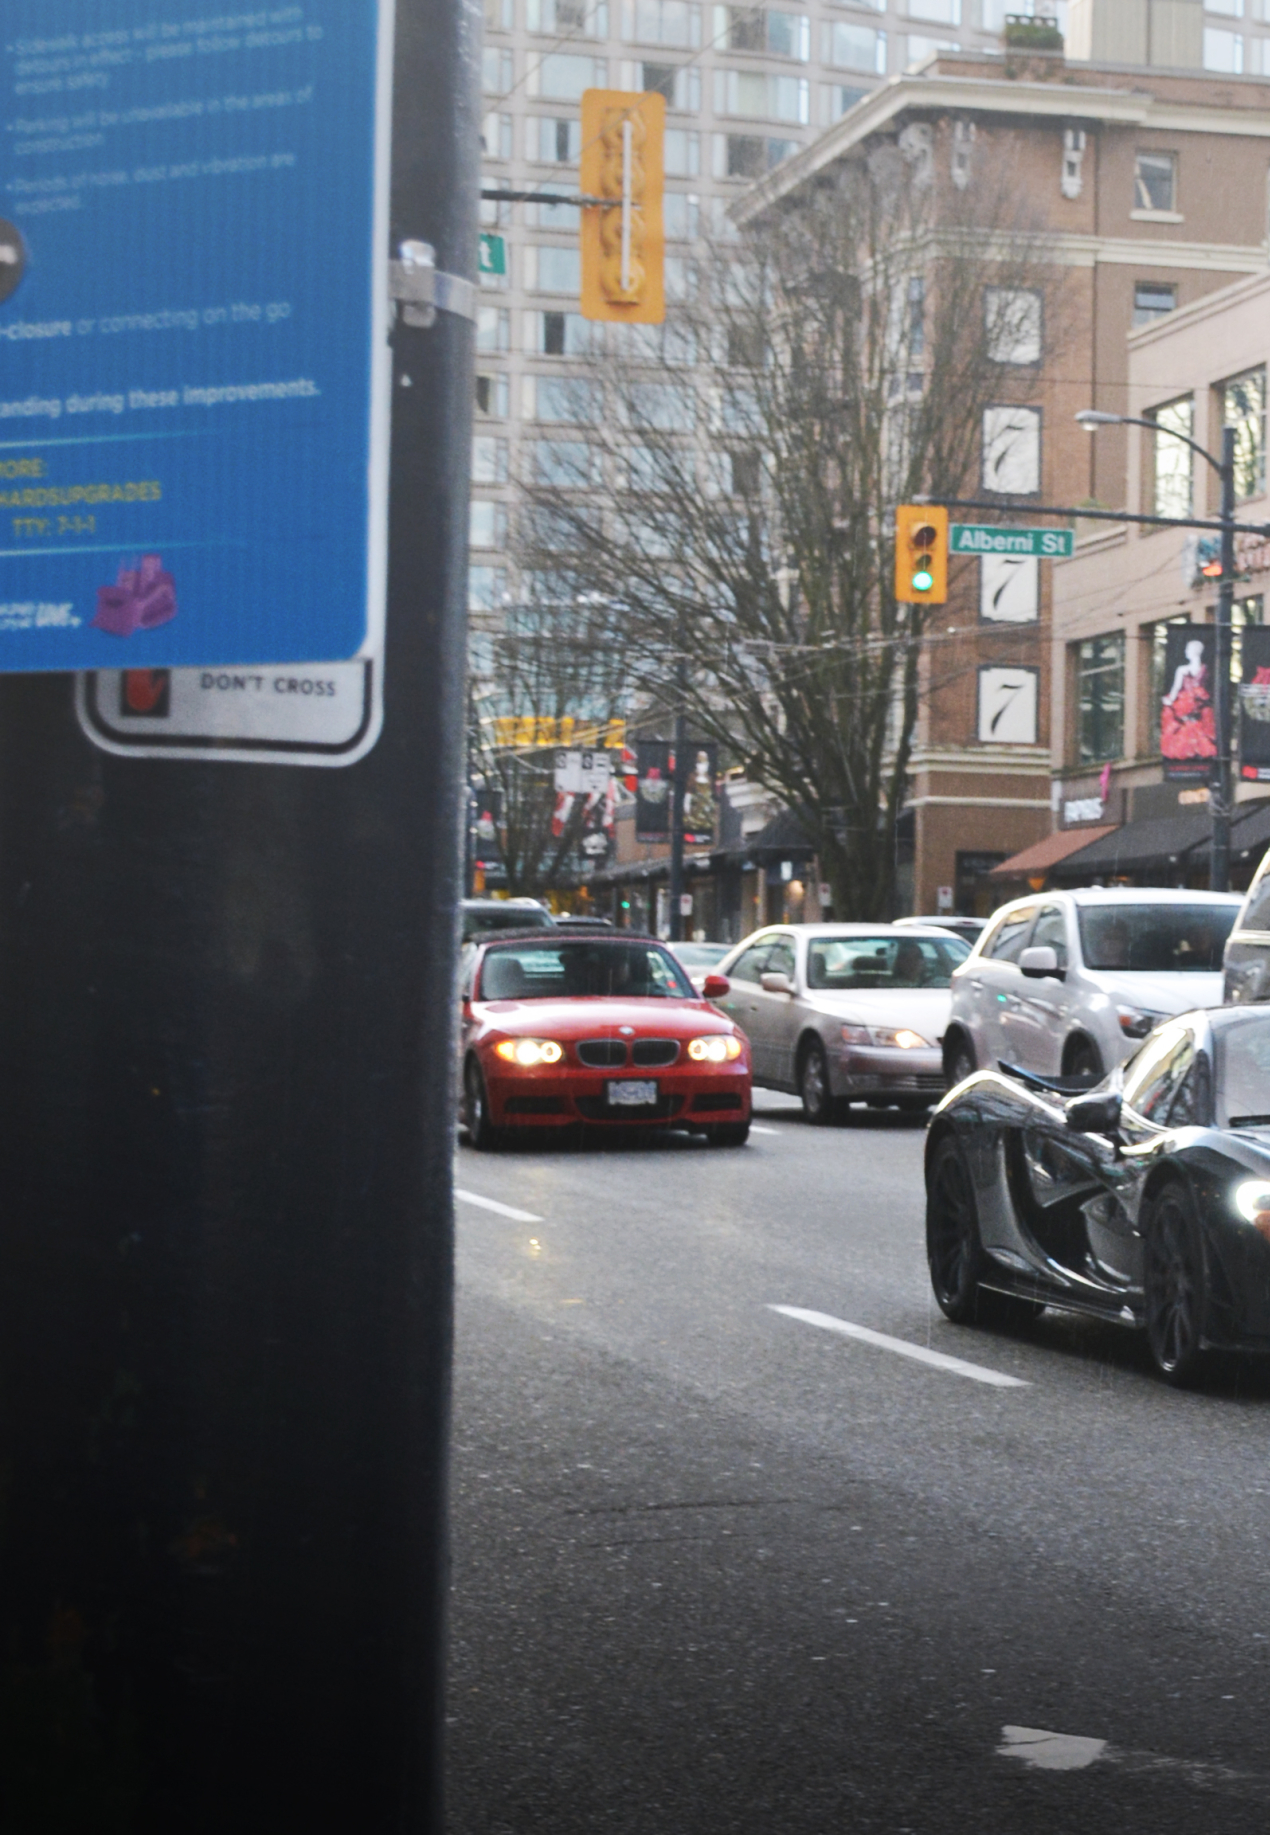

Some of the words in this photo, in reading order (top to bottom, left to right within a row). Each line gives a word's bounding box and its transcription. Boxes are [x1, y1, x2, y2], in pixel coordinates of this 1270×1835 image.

[101, 308, 198, 334] connecting
[203, 307, 227, 325] on
[231, 302, 261, 322] the
[265, 302, 292, 323] go
[65, 393, 124, 414] during
[128, 389, 178, 409] these
[183, 377, 321, 406] improvements.
[958, 529, 1034, 552] Alberni
[1042, 533, 1066, 553] St
[993, 557, 1026, 612] 7
[201, 673, 264, 691] DON'T
[274, 677, 336, 697] CROSS
[990, 681, 1027, 736] 7
